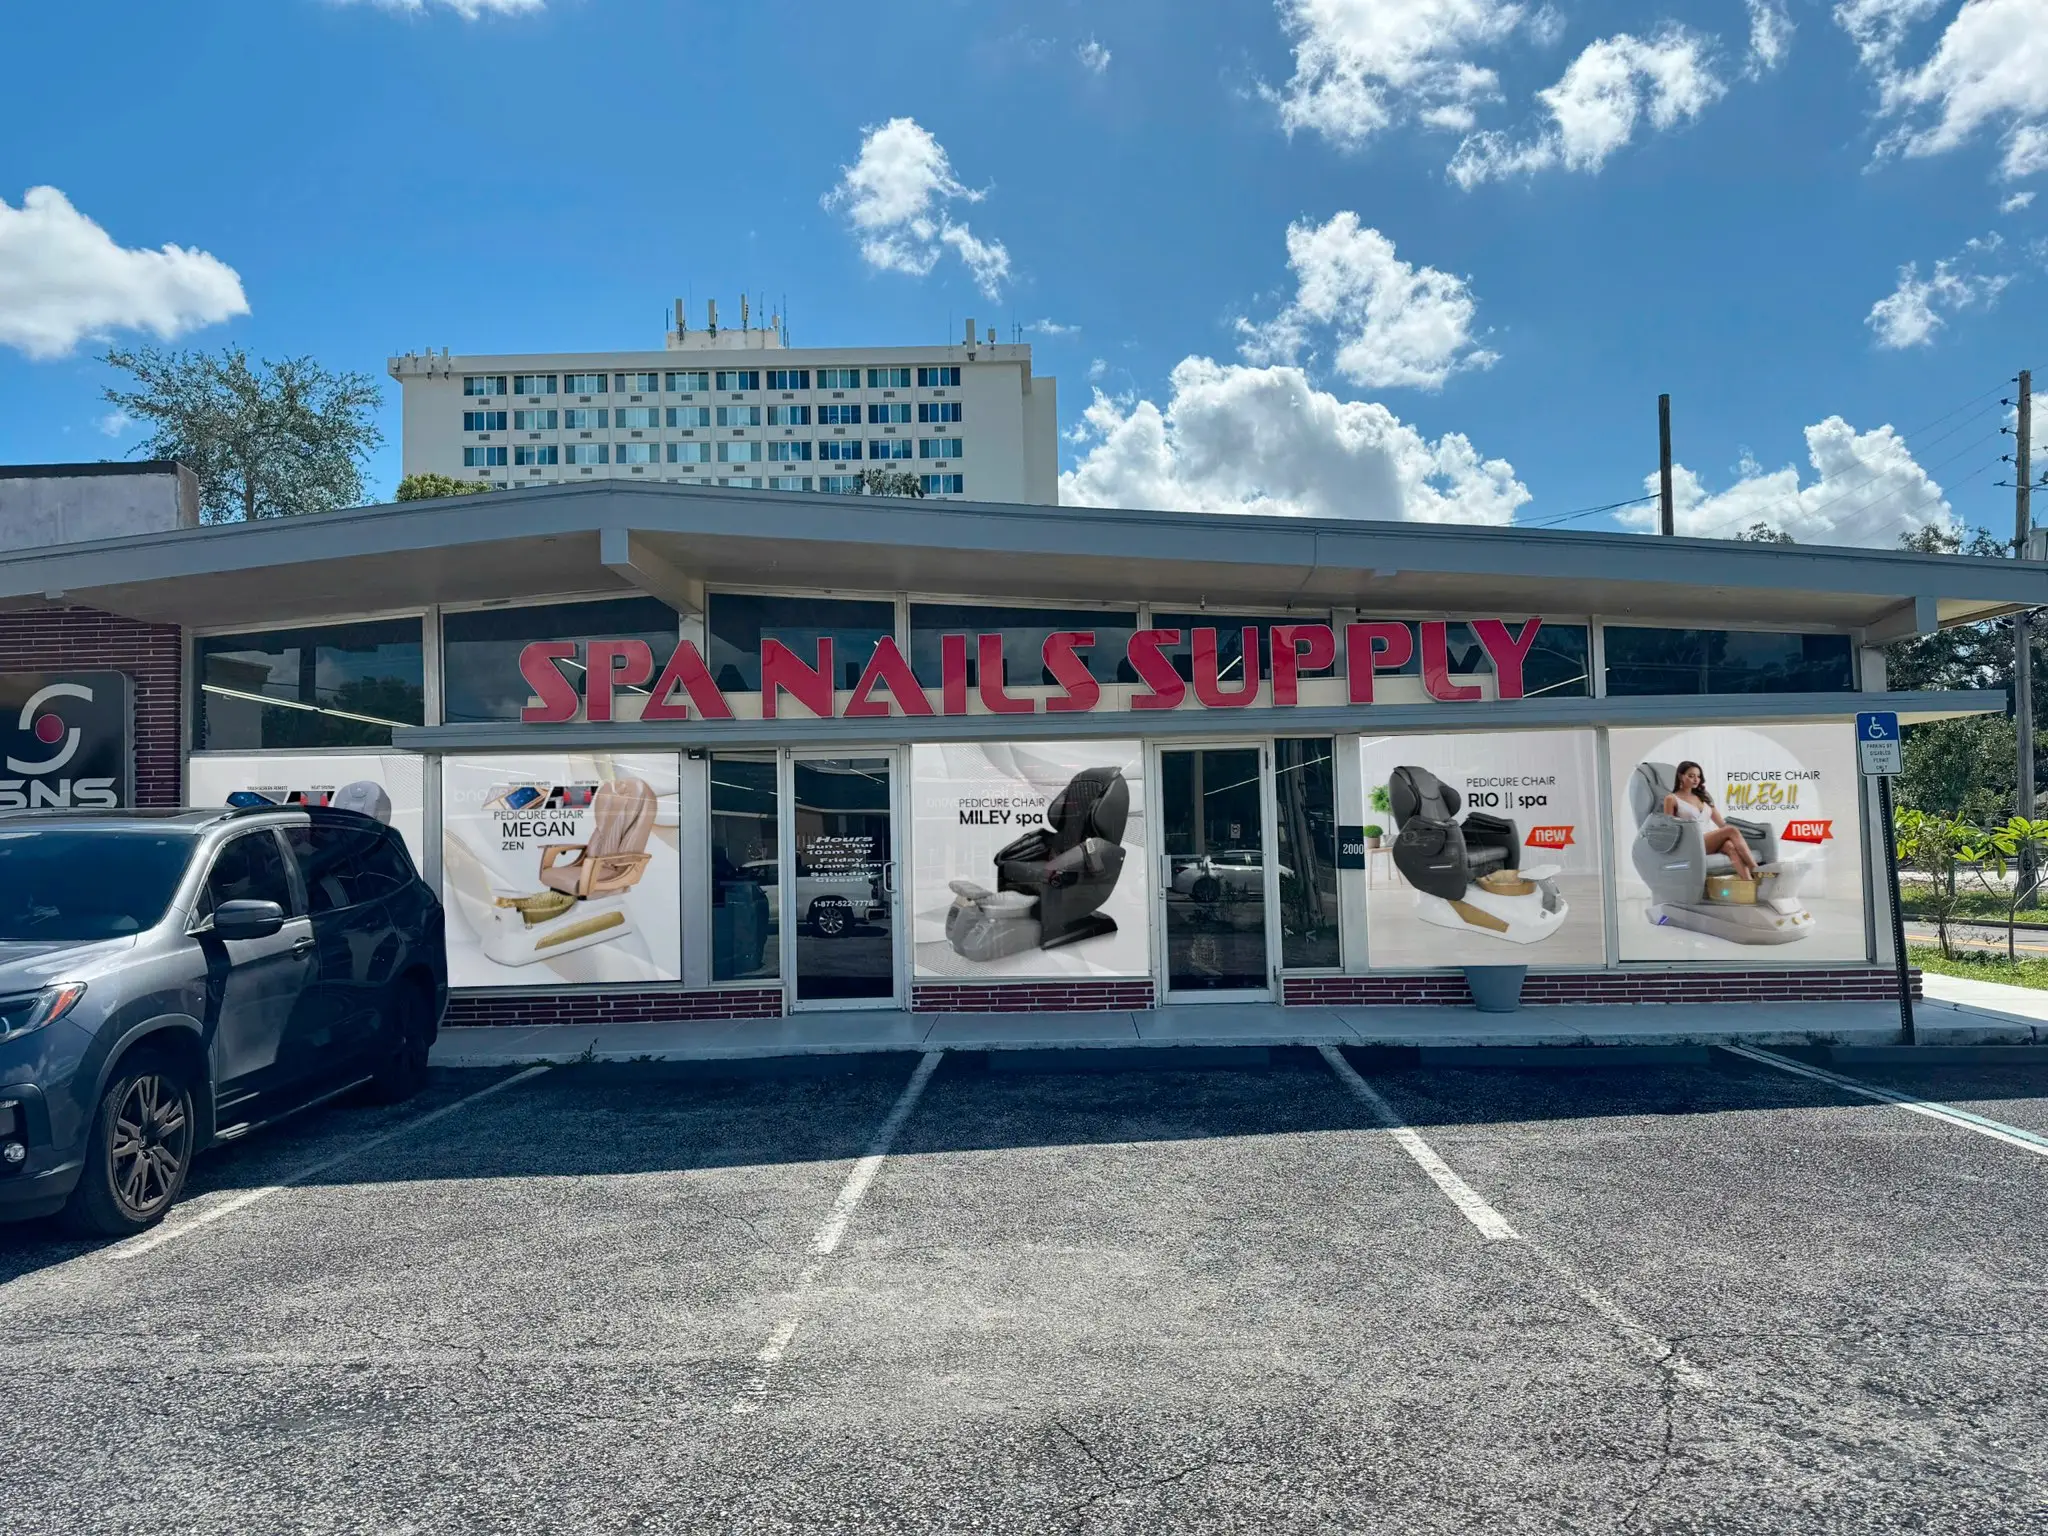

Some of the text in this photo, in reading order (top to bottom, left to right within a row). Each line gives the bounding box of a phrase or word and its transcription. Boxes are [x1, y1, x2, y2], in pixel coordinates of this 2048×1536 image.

[519, 617, 1542, 724] SPA NAILS SUPPLY
[1466, 776, 1556, 787] PEDICURE CHAIR
[1727, 771, 1820, 781] PEDICURE CHAIR
[0, 778, 118, 809] SNS
[1468, 792, 1499, 807] RIO
[1518, 795, 1547, 809] spa
[959, 798, 1010, 807] PEDICURE
[1012, 797, 1045, 807] CHAIR
[493, 809, 584, 820] PEDICURE CHAIR
[959, 810, 1043, 827] MILEY spa
[502, 821, 575, 838] MEGAN
[1535, 829, 1567, 843] new
[1791, 823, 1825, 837] new
[502, 841, 525, 851] ZEN
[1342, 843, 1364, 855] 2000
